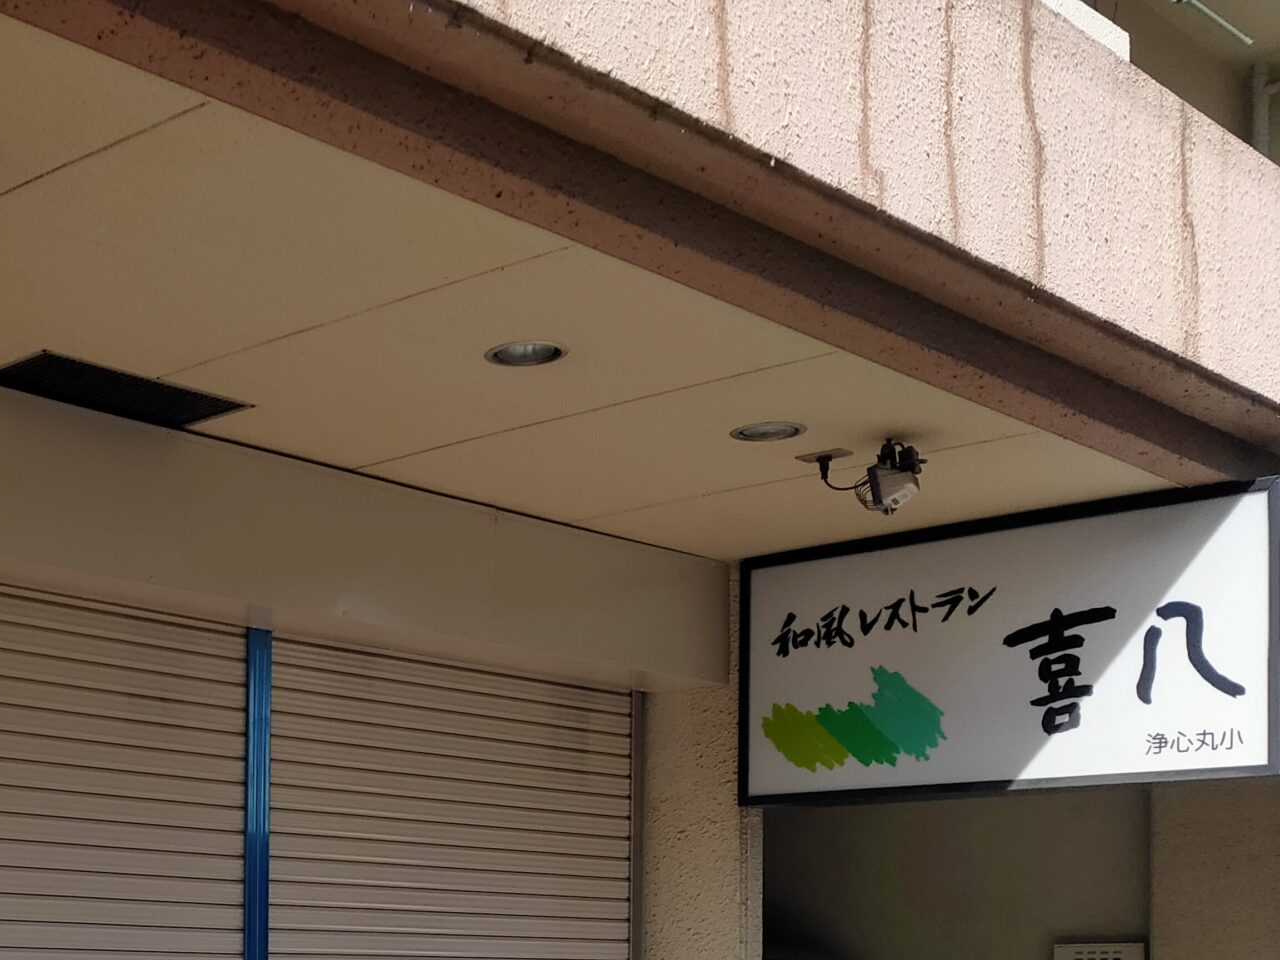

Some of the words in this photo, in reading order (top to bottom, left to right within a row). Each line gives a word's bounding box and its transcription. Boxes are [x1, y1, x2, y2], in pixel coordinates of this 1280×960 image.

[770, 585, 997, 657] 和風レストラン
[1144, 728, 1244, 756] 浄心丸小
